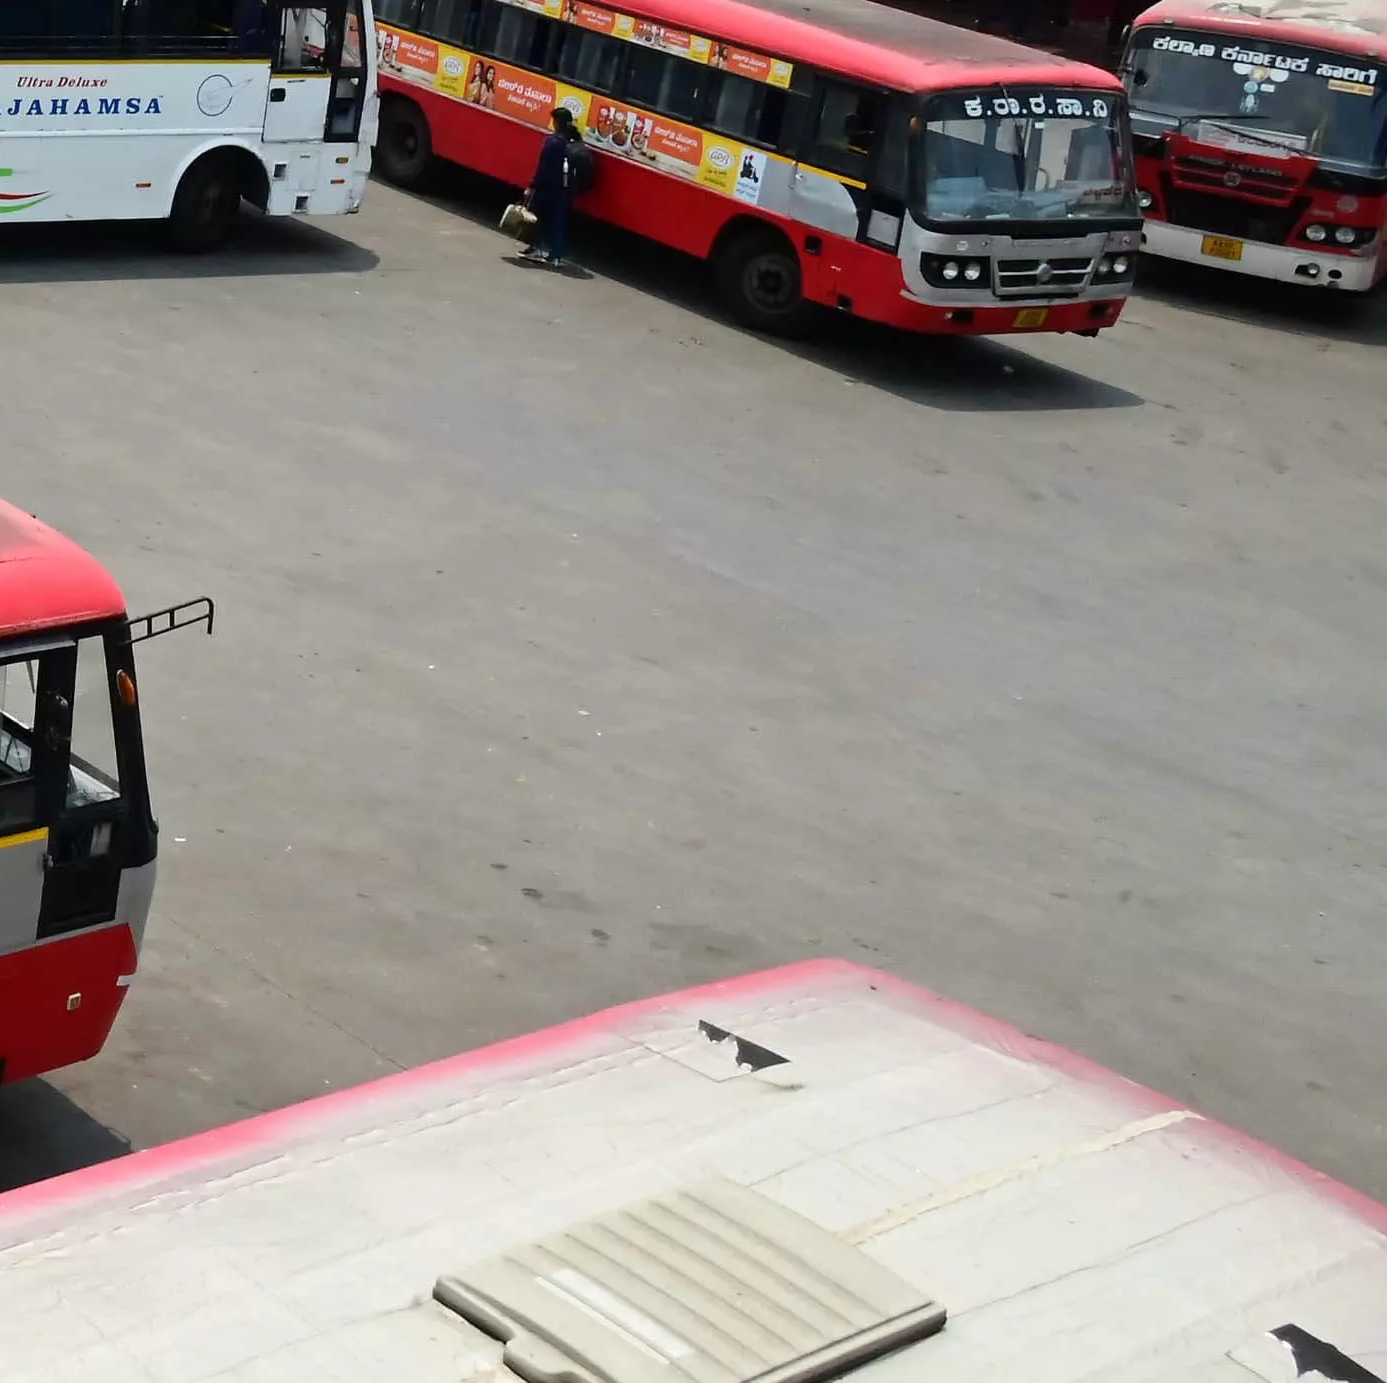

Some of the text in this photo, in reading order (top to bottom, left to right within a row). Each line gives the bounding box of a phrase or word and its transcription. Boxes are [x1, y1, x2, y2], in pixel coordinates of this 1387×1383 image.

[1153, 36, 1215, 57] ಕಲ್ಯಾಣ
[1221, 47, 1309, 73] ಕರ್ನಾಟಕ
[17, 76, 108, 88] Ultra Deluxe
